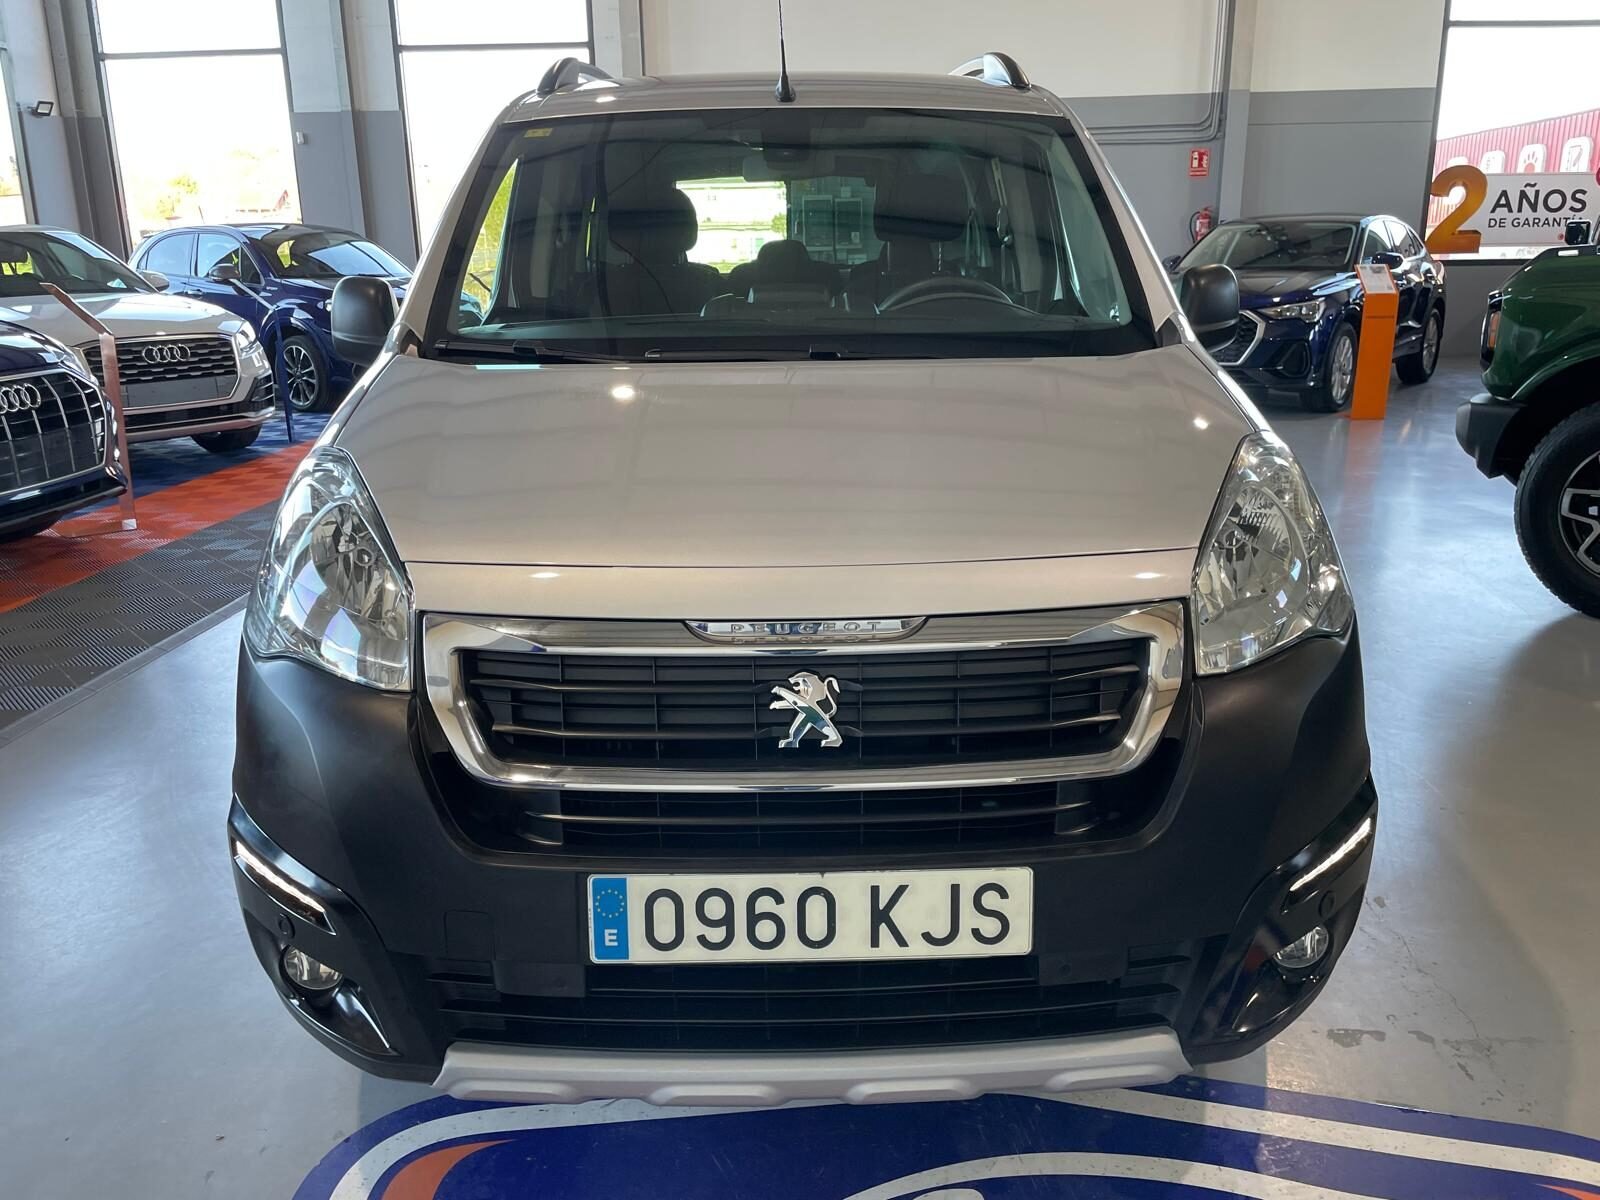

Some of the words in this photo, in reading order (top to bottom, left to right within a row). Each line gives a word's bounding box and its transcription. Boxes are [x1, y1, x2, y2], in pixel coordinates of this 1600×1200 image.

[1425, 165, 1488, 253] 2
[1490, 182, 1588, 213] AÑOS
[1488, 218, 1506, 228] DE
[1511, 214, 1583, 228] GARANT
[731, 621, 880, 635] PEUGEOT
[645, 886, 836, 951] 0960
[870, 882, 1010, 948] KJS
[604, 928, 618, 946] E
